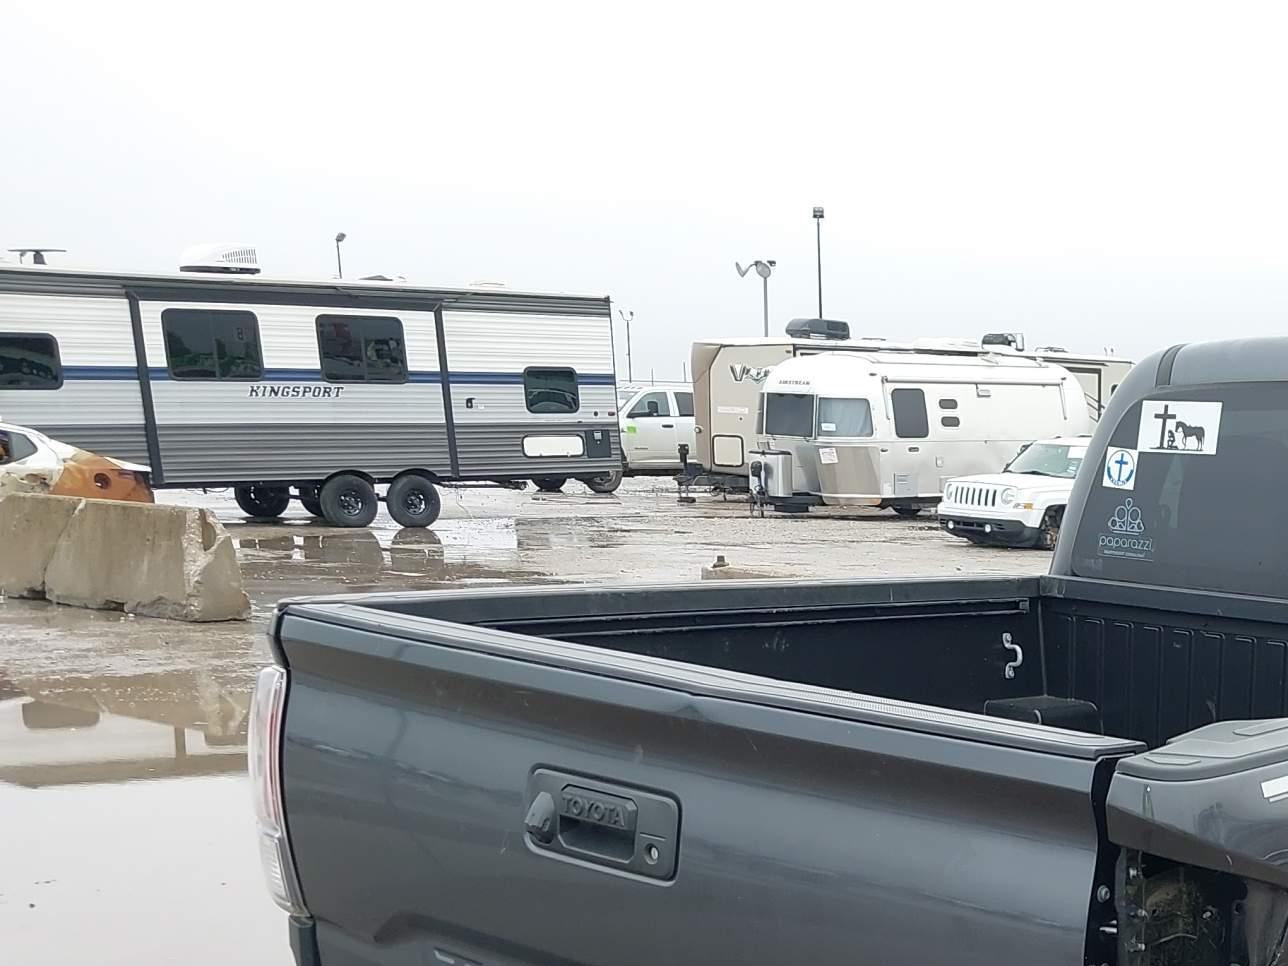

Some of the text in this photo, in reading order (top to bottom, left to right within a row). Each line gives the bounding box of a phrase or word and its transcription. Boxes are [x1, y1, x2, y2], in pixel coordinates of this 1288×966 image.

[249, 385, 344, 398] KINGSPORT
[1099, 535, 1153, 551] paparazzi
[559, 793, 627, 830] TOYOTA
